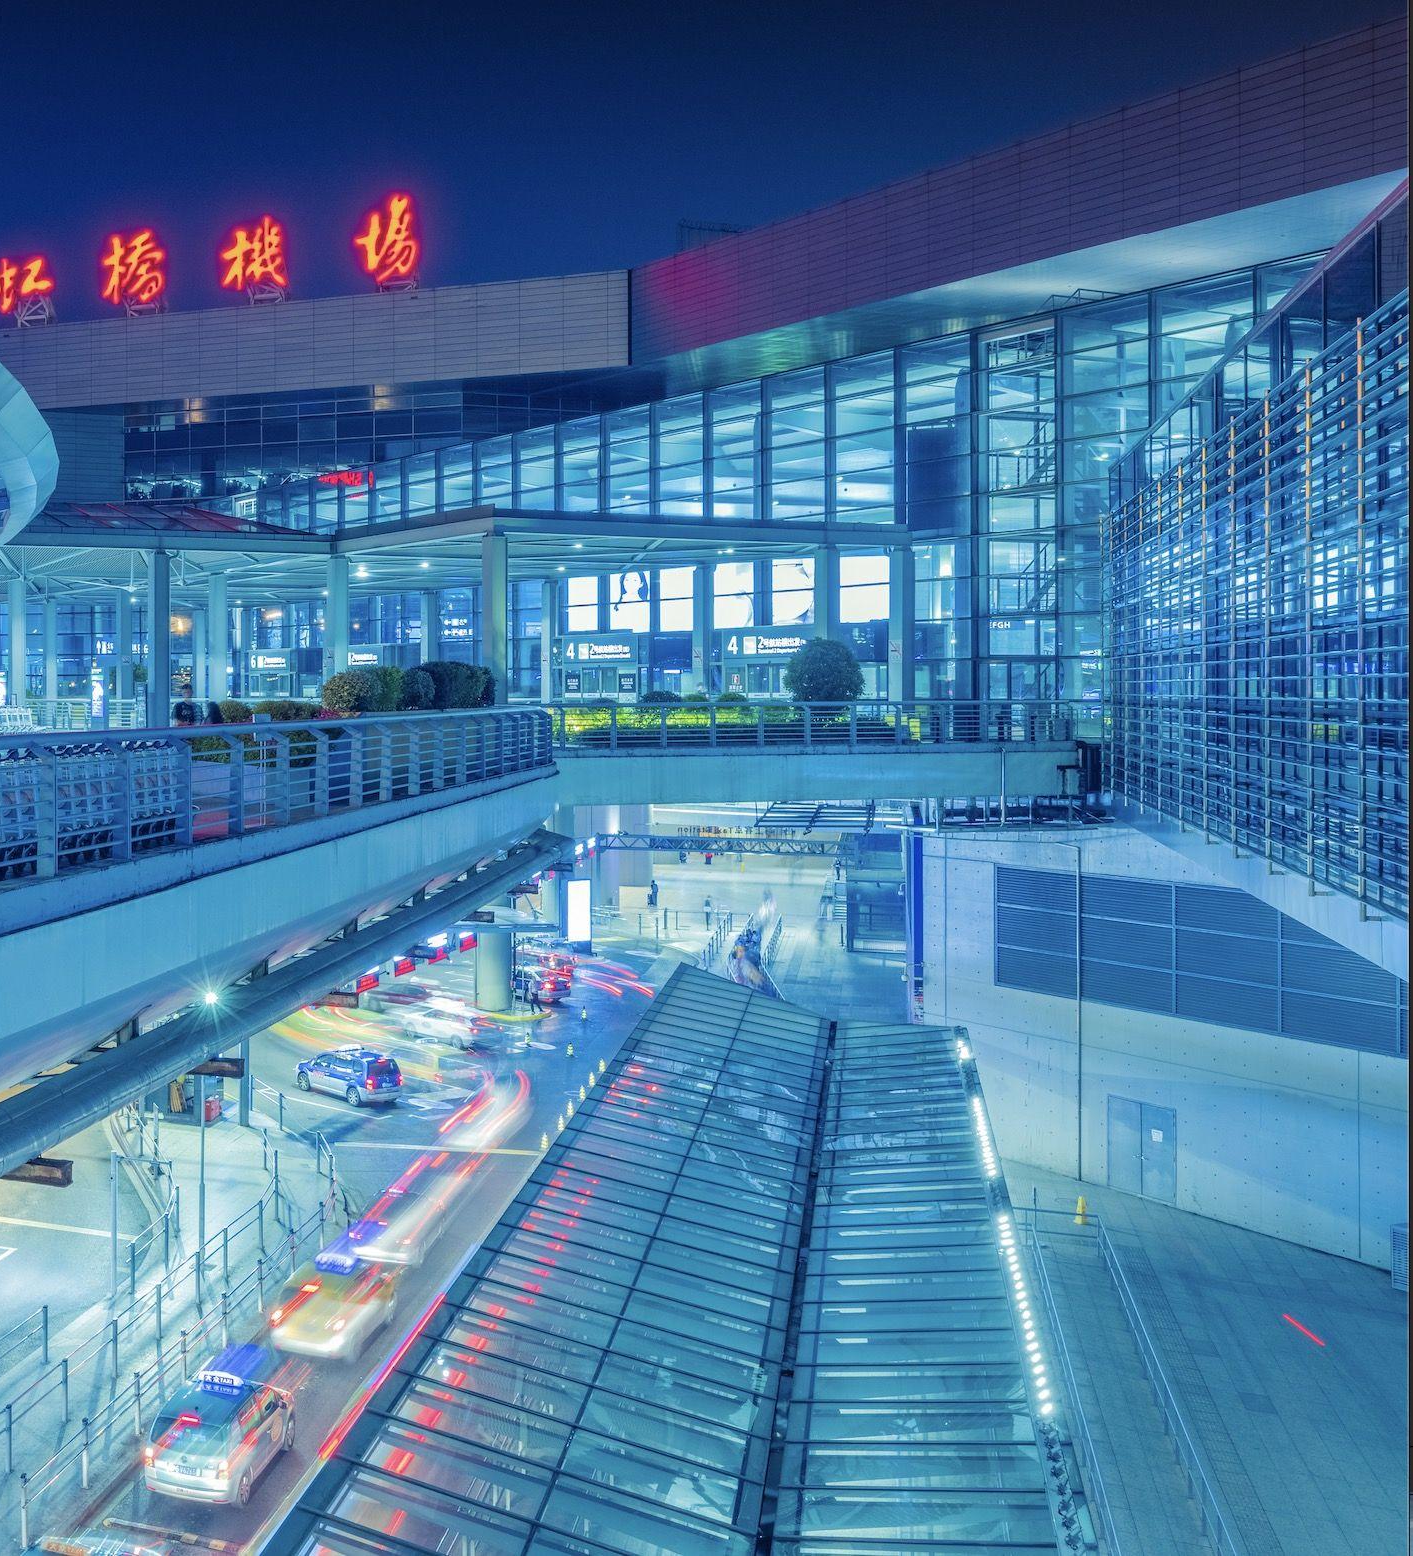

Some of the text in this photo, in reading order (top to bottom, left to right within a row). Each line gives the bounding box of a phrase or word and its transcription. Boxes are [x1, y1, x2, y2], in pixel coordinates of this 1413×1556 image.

[566, 642, 575, 660] 4
[727, 635, 739, 655] 4
[250, 654, 256, 669] 6
